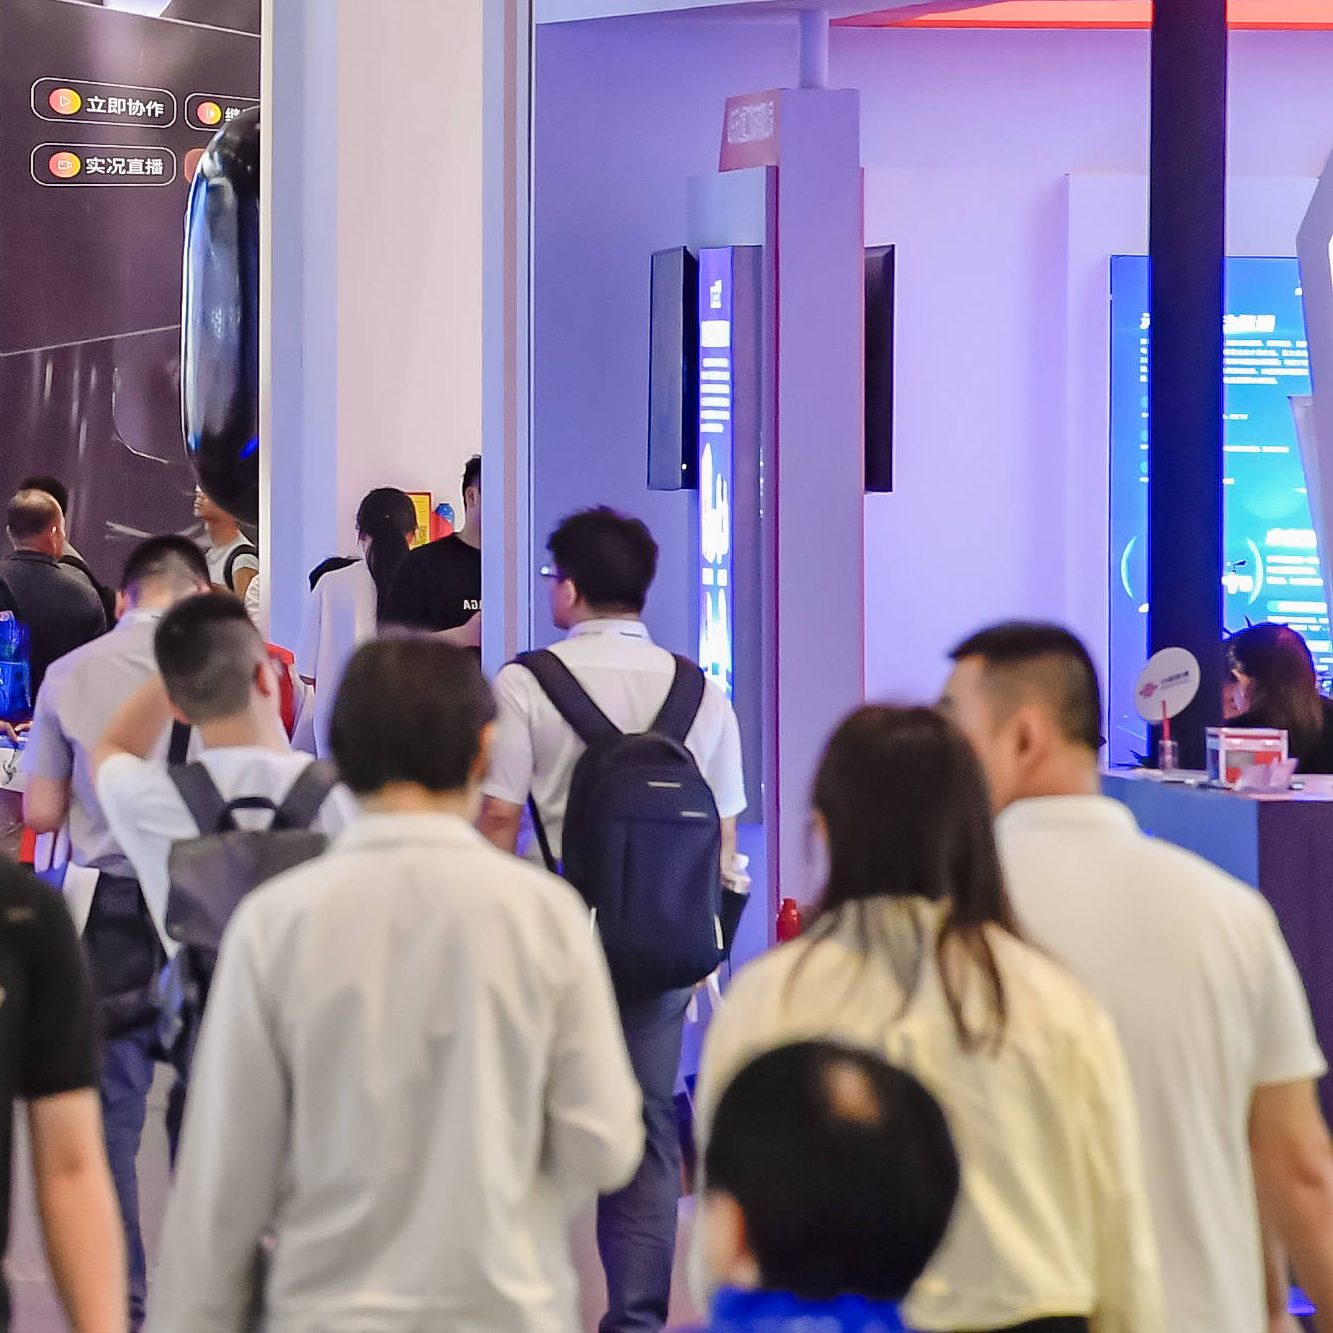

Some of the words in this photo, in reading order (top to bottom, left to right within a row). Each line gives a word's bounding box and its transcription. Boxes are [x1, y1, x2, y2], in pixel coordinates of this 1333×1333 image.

[85, 96, 165, 118] 立即协作
[85, 156, 165, 176] 实况直播
